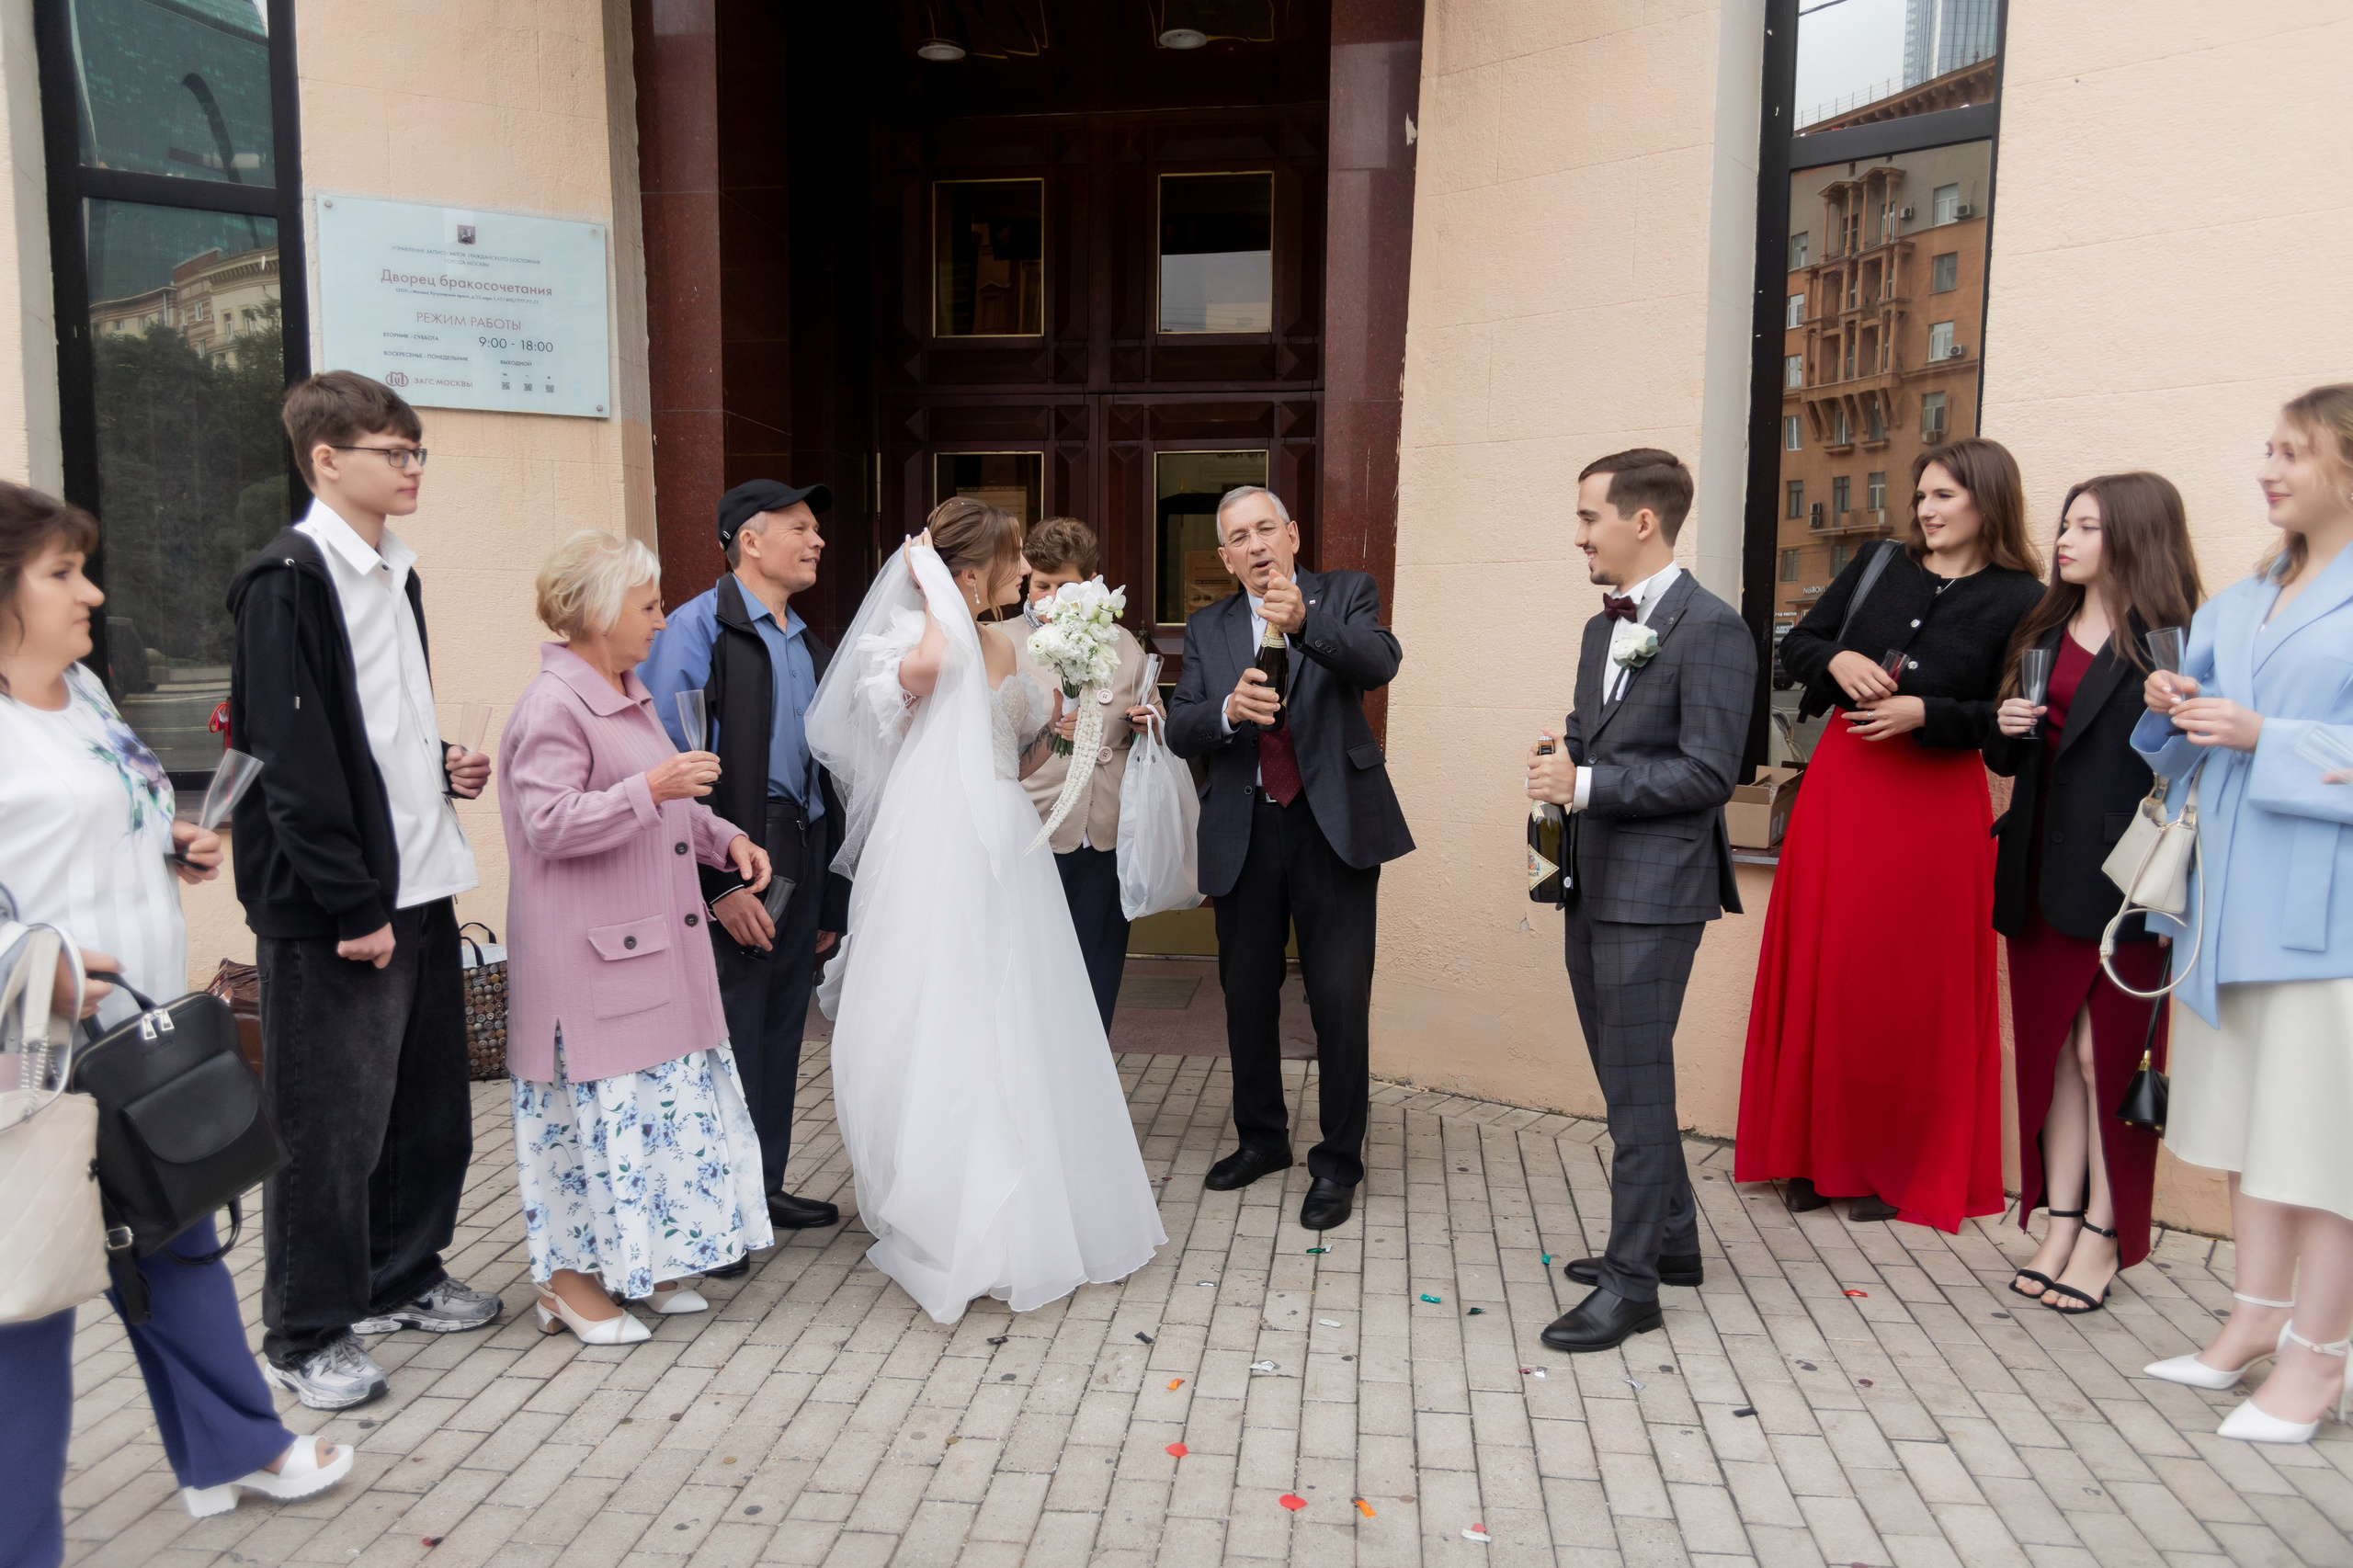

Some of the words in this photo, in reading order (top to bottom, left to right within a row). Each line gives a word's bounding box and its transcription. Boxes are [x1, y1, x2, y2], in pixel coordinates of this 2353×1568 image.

[391, 245, 425, 254] УПРАВЛЕНИЕ
[468, 253, 508, 262] ГРАЖДАНСКОГО
[381, 268, 437, 287] Дворец
[439, 274, 552, 296] бракосочетания
[416, 312, 466, 326] РЕЖИМ
[471, 316, 521, 331] РАБОТЫ
[479, 336, 507, 348] 9:00
[520, 339, 554, 353] 18:00
[383, 350, 423, 358] ВОСКРЕСЕНЬЕ
[414, 377, 435, 385] ЗАГС
[436, 379, 473, 388] МОСКВЫ
